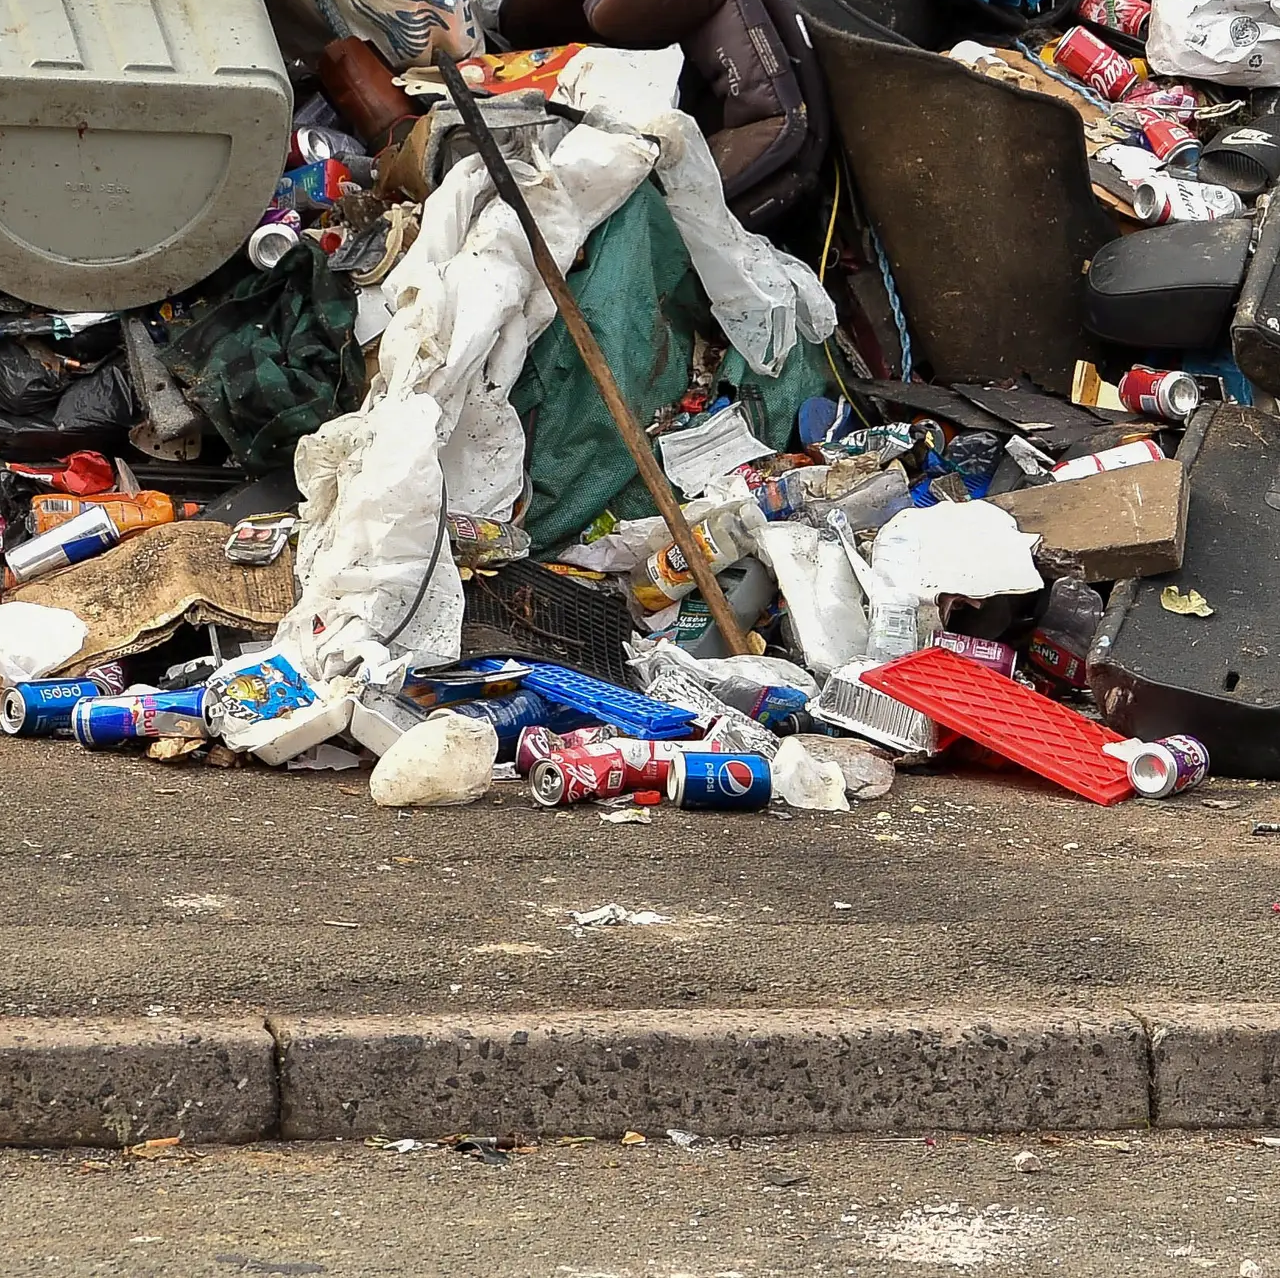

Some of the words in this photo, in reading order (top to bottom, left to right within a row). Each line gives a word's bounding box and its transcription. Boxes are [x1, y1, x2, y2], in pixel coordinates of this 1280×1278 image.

[39, 682, 82, 703] pepsi
[142, 708, 160, 737] Bull
[704, 762, 717, 794] pepsi
